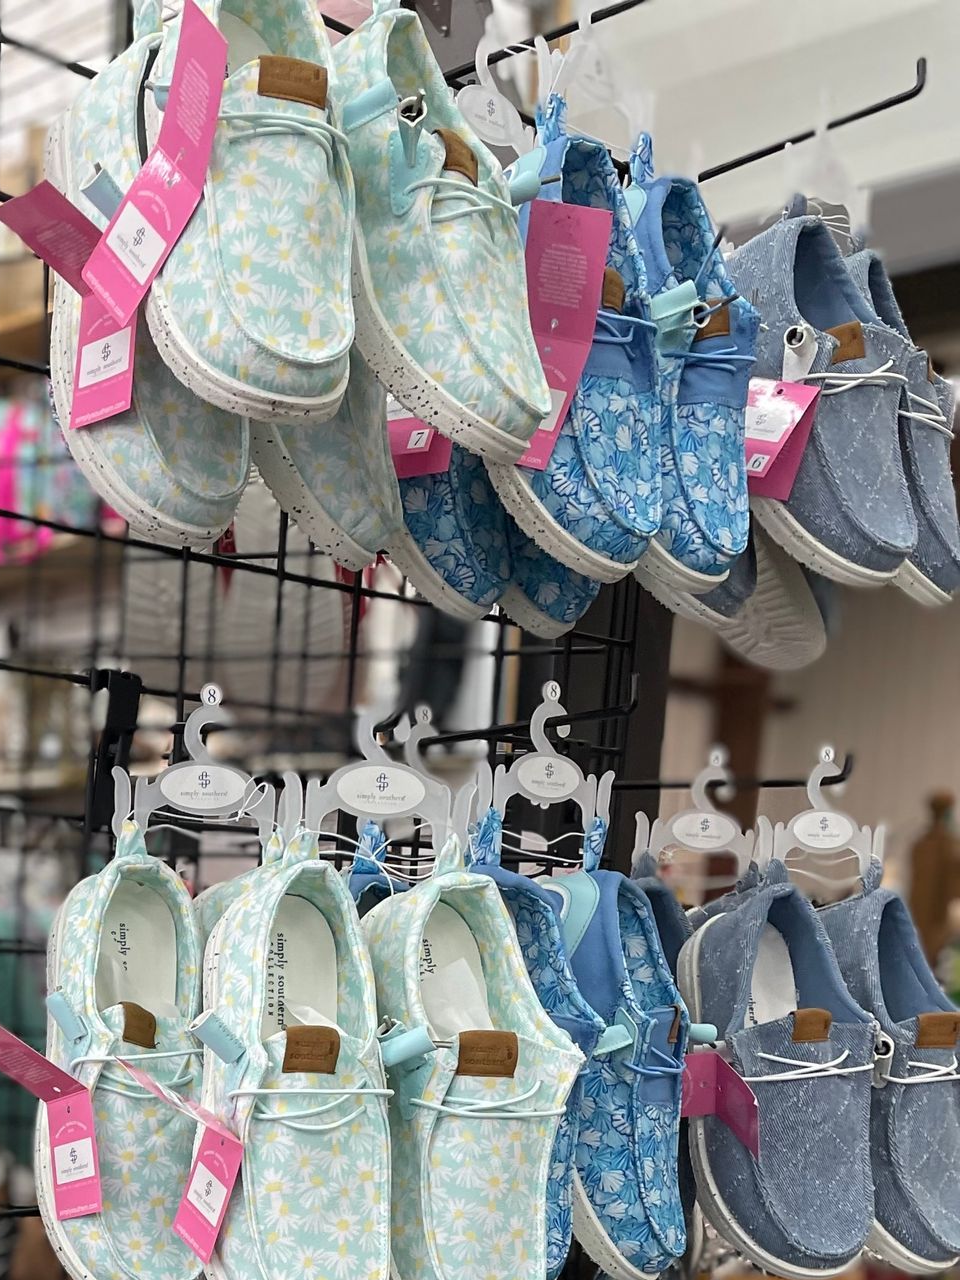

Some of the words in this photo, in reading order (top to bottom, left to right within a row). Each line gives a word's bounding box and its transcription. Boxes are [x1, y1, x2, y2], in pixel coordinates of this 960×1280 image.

[414, 431, 425, 446] 7
[751, 456, 765, 469] 6
[207, 688, 217, 703] 8
[550, 684, 558, 698] 8
[422, 709, 429, 720] 8
[117, 922, 131, 956] simply
[274, 932, 288, 970] simply
[422, 938, 437, 974] simply
